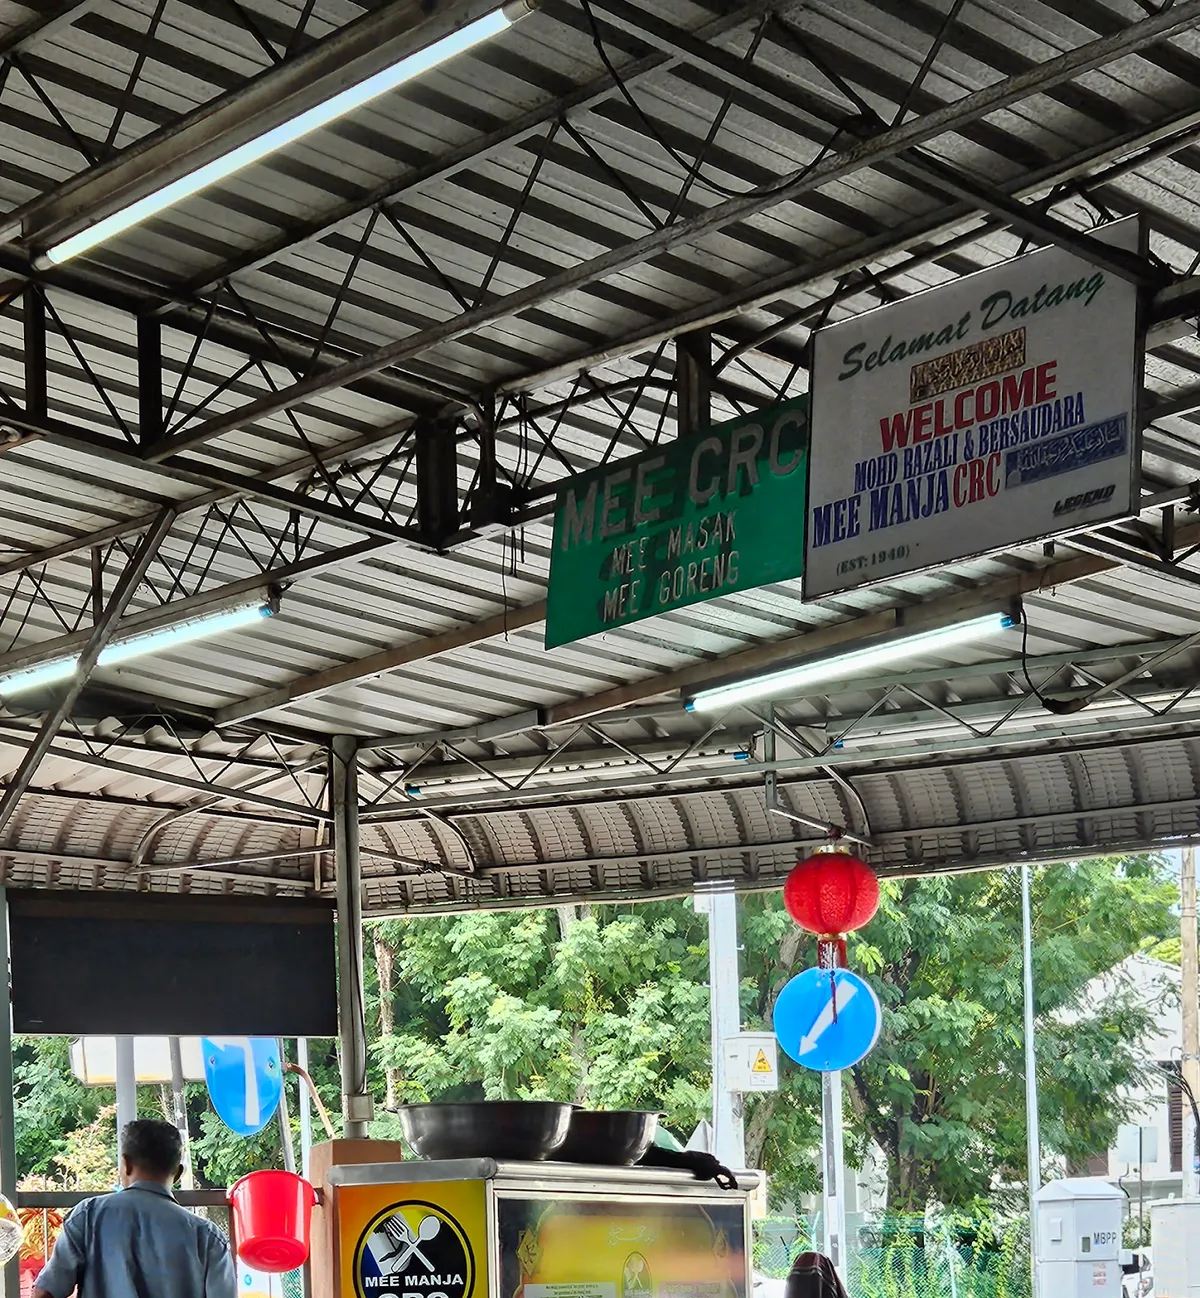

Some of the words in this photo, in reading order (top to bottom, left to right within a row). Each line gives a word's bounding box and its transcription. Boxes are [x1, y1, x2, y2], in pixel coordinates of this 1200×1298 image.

[838, 311, 971, 382] Selamat
[980, 271, 1105, 330] Datang
[854, 455, 898, 495] MOHD
[903, 435, 959, 480] RAZALI
[964, 429, 975, 458] &
[978, 391, 1085, 455] BERSAUDARA
[879, 360, 1058, 453] WELCOME
[561, 454, 666, 551] MEE
[689, 408, 808, 504] CRC
[812, 494, 860, 549] MEE
[868, 469, 949, 533] MANJA
[953, 452, 1001, 509] CRC
[603, 579, 641, 623] MEE
[659, 551, 739, 604] GORENG
[612, 536, 649, 577] MEE
[667, 510, 738, 561] MASAK
[365, 1276, 399, 1287] MEE
[405, 1274, 464, 1286] MANJA
[1093, 1232, 1117, 1244] MBPP
